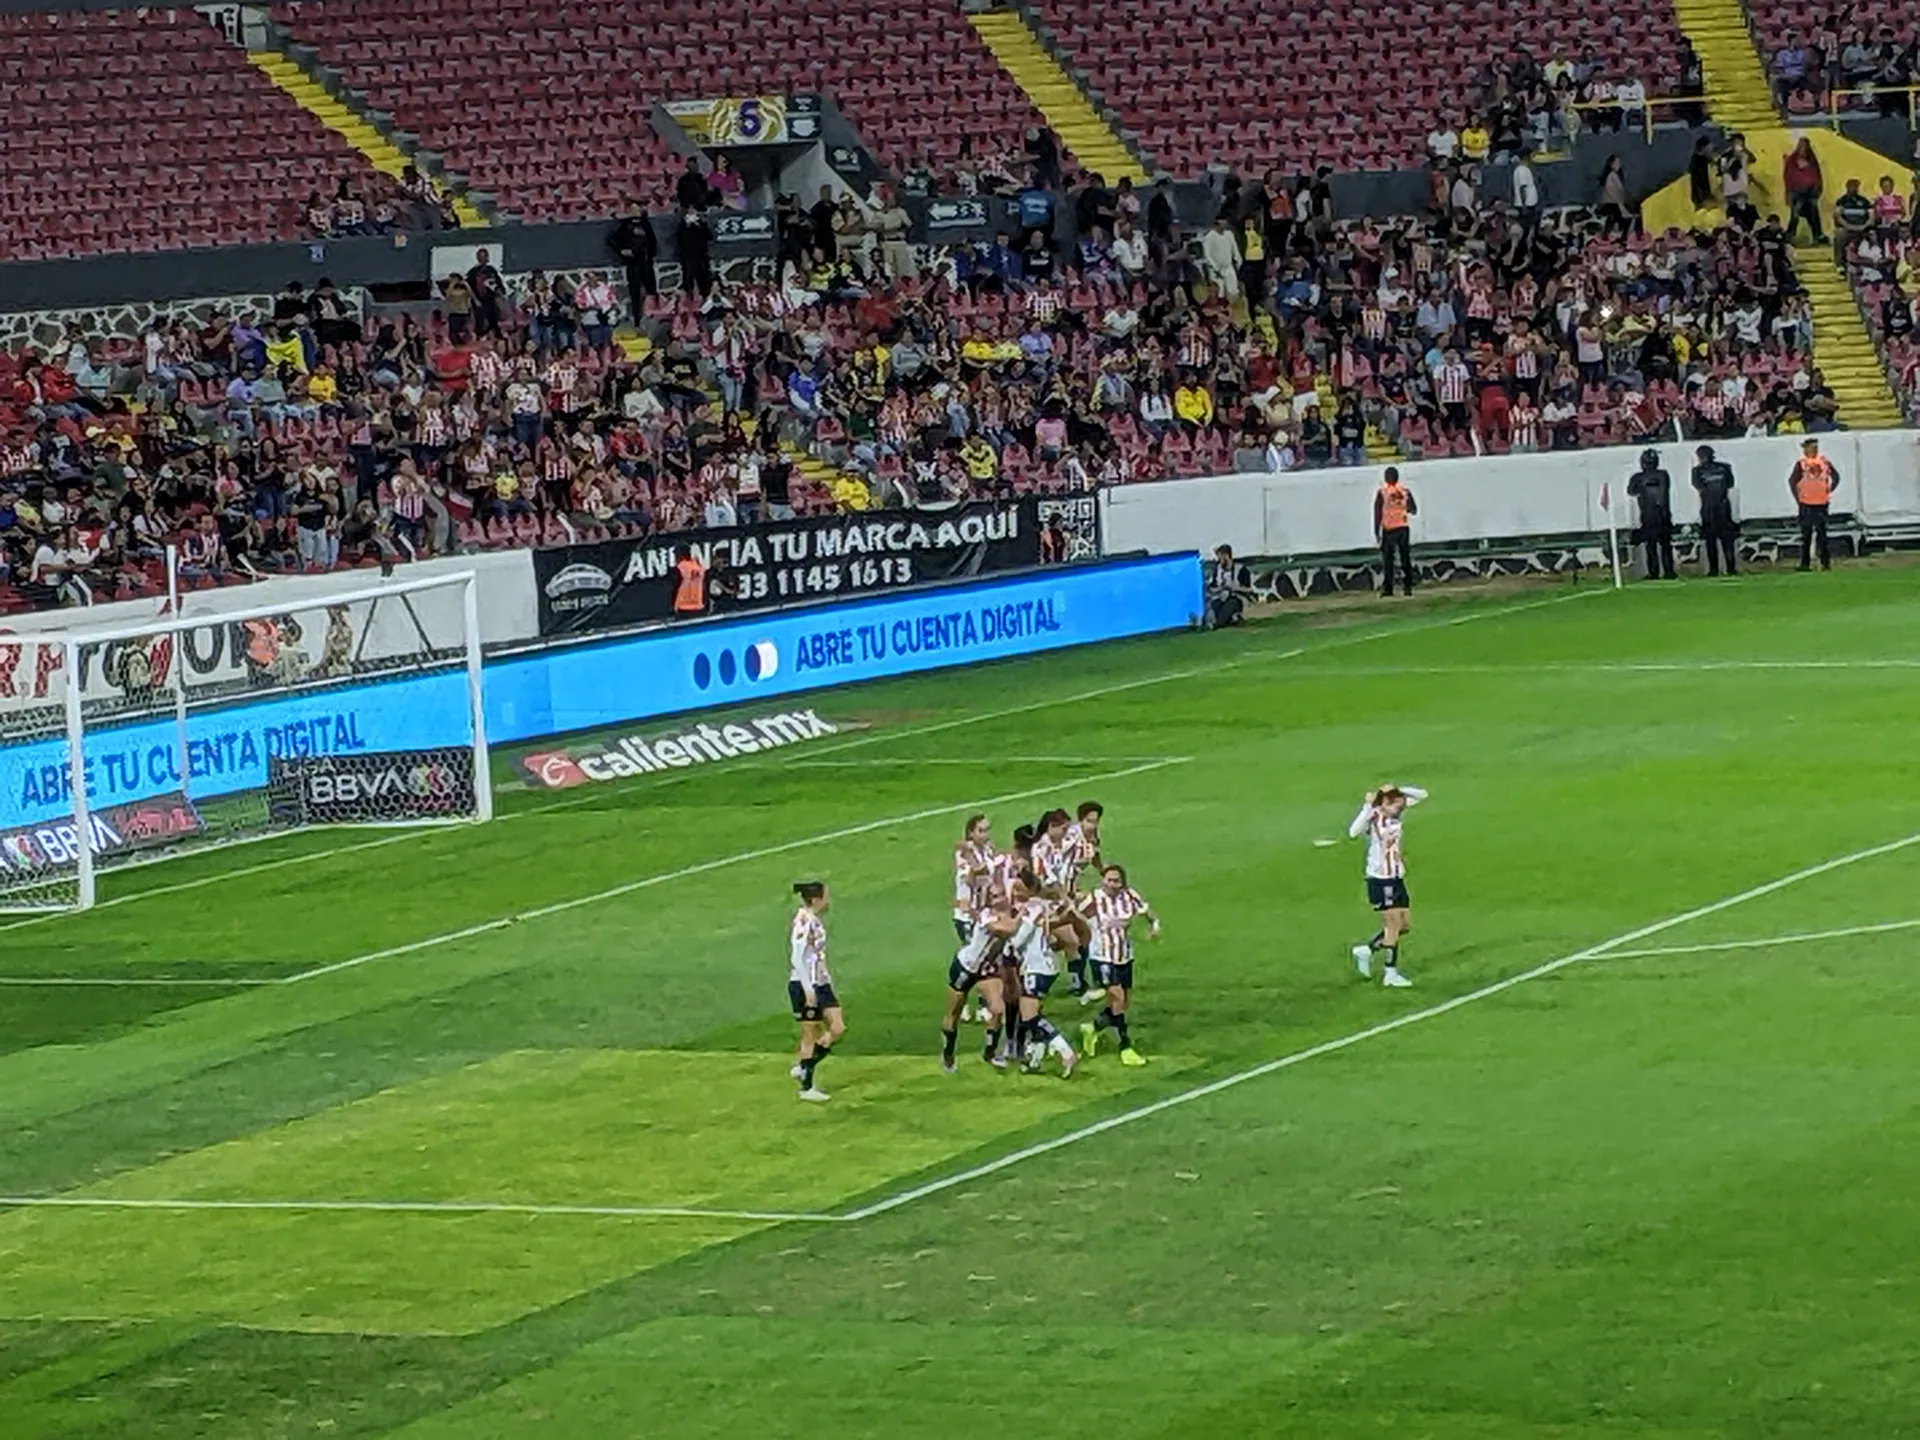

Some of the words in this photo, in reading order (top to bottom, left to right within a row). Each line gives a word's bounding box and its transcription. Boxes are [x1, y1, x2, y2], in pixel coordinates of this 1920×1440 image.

[768, 530, 808, 561] TU
[815, 523, 930, 557] MARCA
[736, 571, 769, 600] 33
[777, 564, 841, 595] 1145
[850, 558, 912, 587] 1613
[796, 628, 854, 672] ABRE
[858, 623, 886, 660] TU
[892, 610, 977, 653] CUENTA
[981, 598, 1060, 642] DIGITAL
[102, 750, 140, 792] TU
[147, 730, 260, 785] CUENTA
[264, 711, 366, 758] DIGITAL
[577, 708, 838, 780] caliente.mx
[310, 767, 407, 803] BBVA
